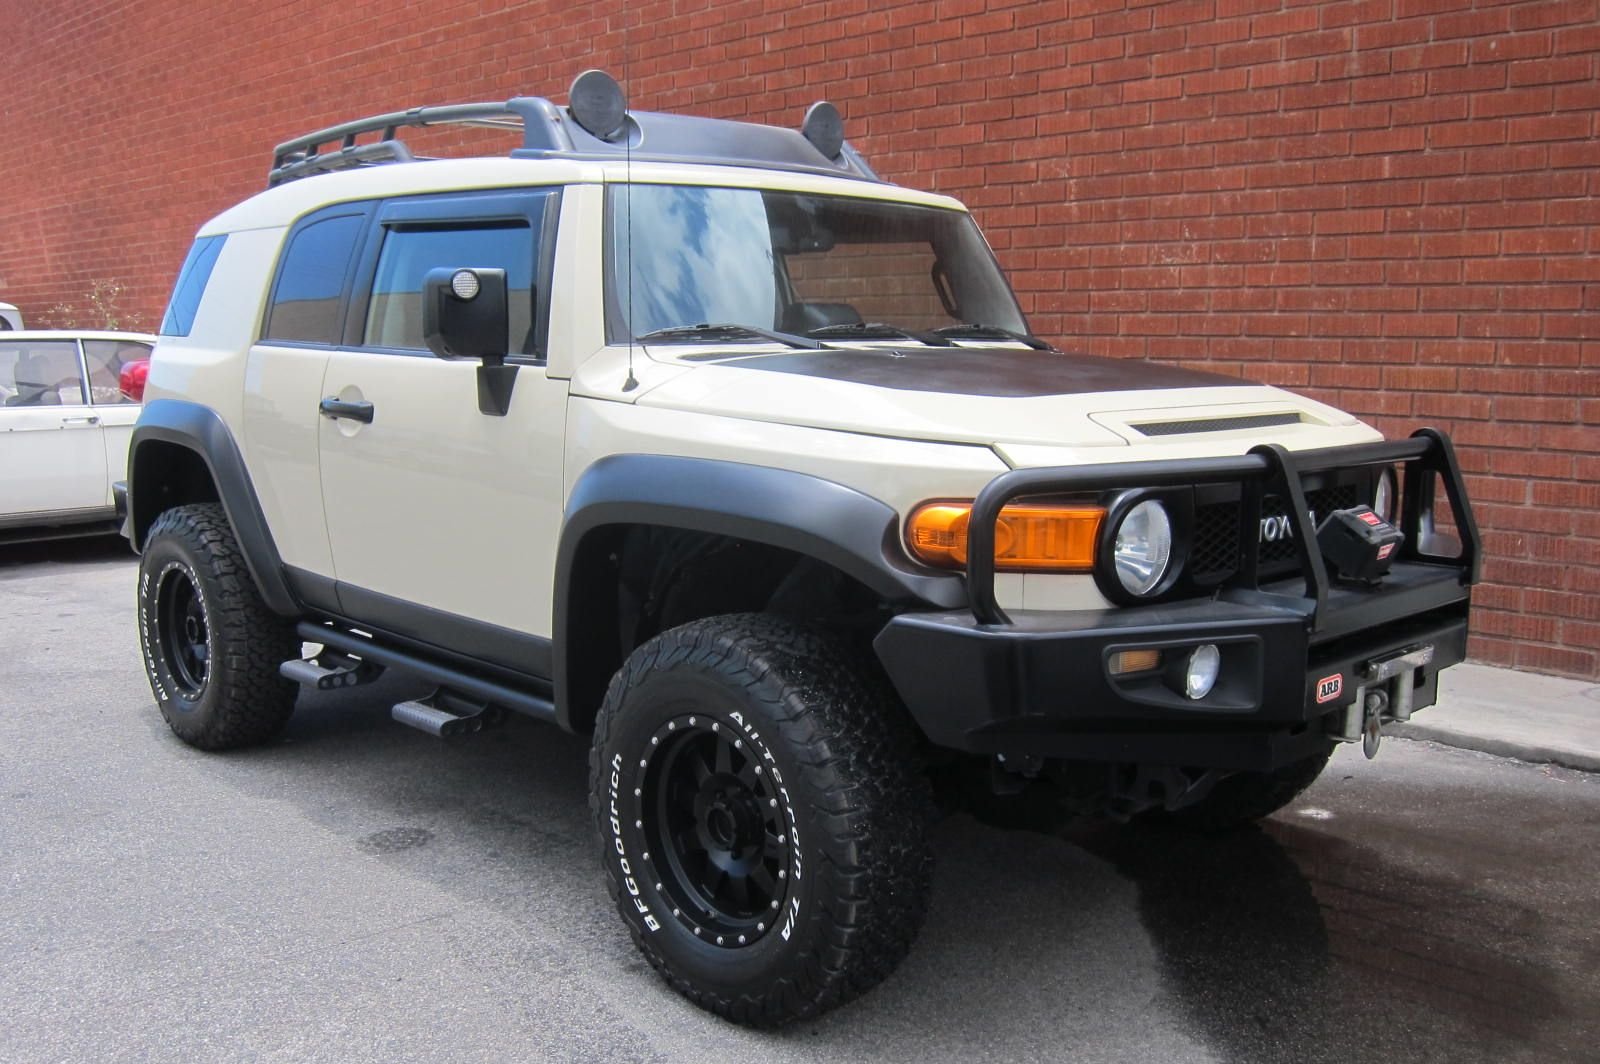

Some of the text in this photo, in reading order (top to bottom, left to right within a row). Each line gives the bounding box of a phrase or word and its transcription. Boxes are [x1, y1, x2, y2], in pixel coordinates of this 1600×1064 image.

[1320, 678, 1339, 698] ARB
[608, 753, 661, 932] BFGoodrich
[729, 711, 803, 942] All-Terrain T/A
